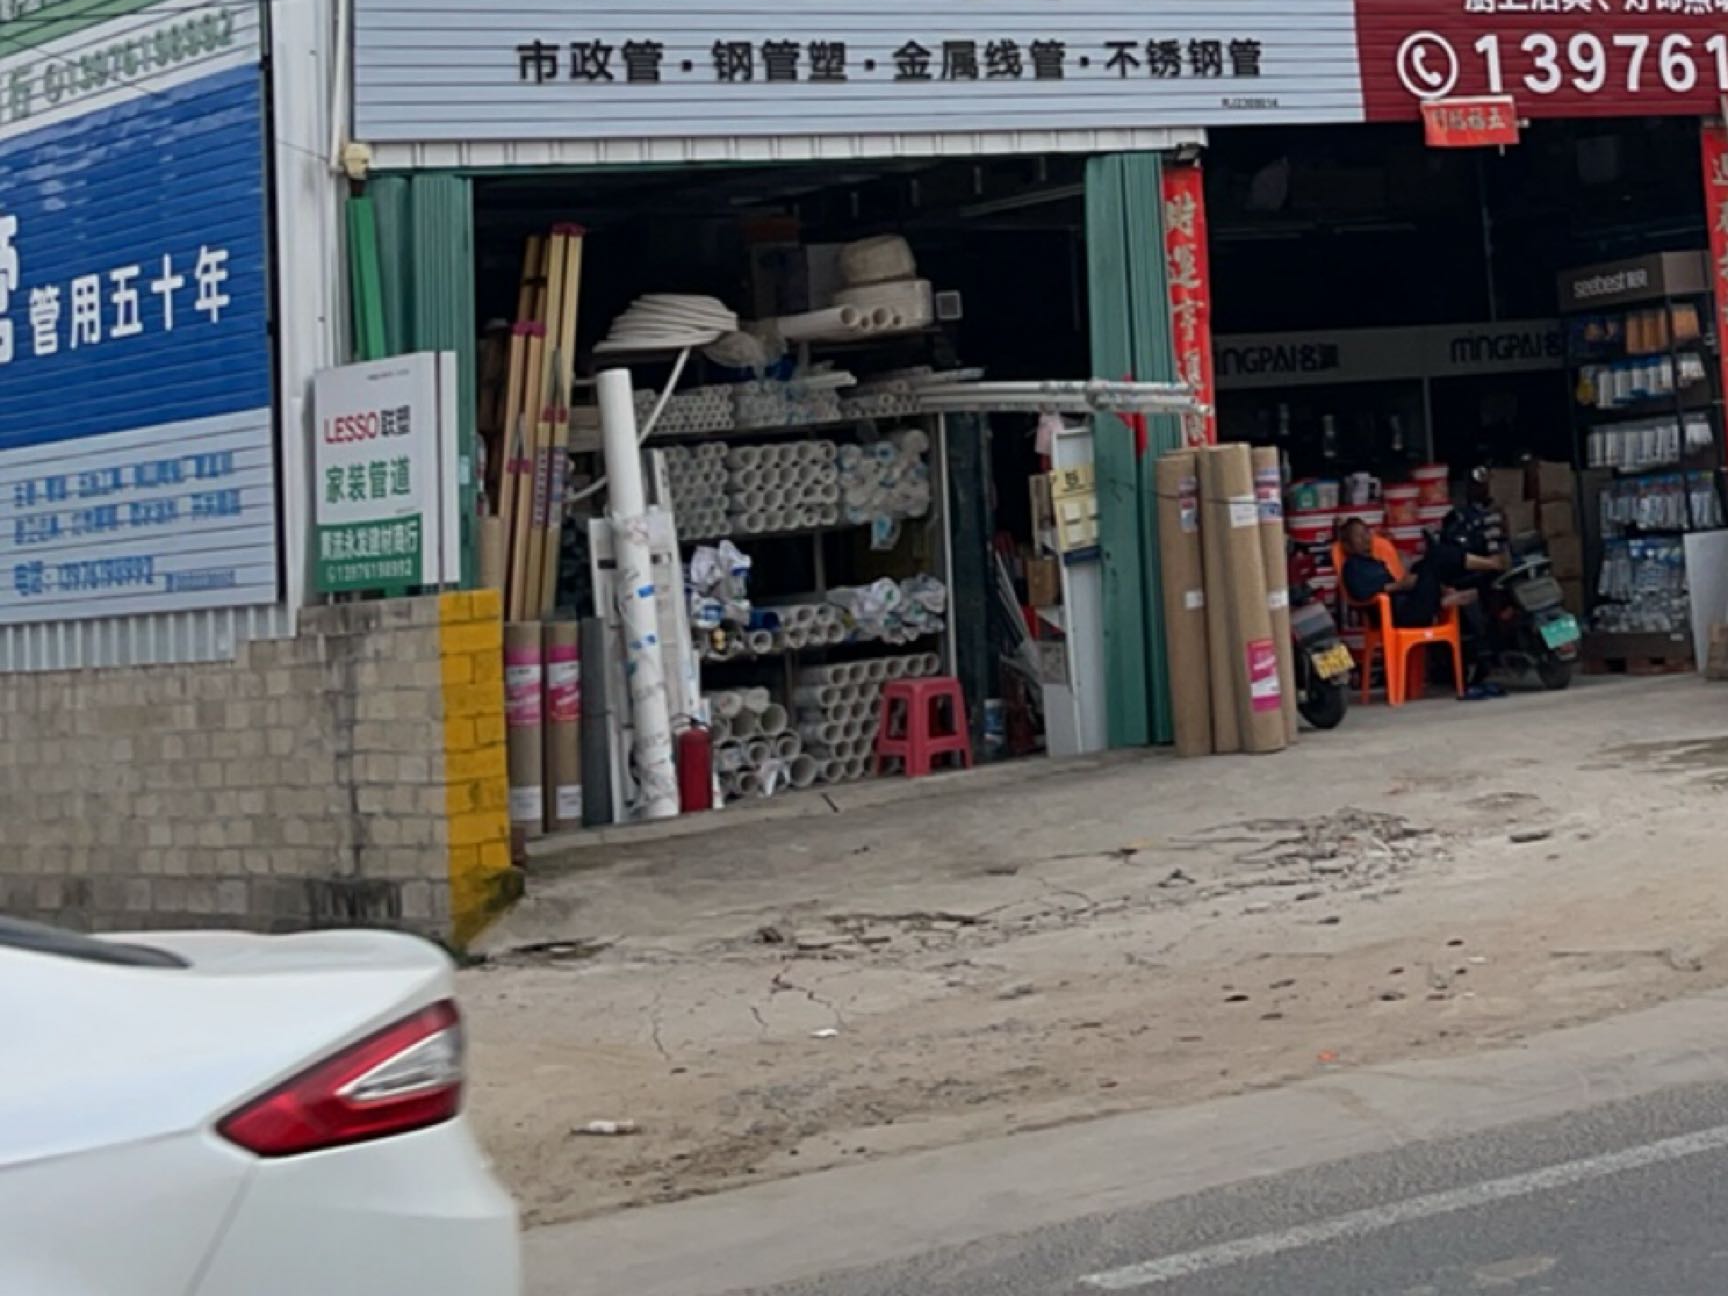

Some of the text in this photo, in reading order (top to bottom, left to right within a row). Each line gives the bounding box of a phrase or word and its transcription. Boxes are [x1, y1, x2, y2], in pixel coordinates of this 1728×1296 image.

[29, 245, 230, 356] 管用五十年
[324, 411, 379, 444] LESSO
[325, 456, 411, 504] 家装管道
